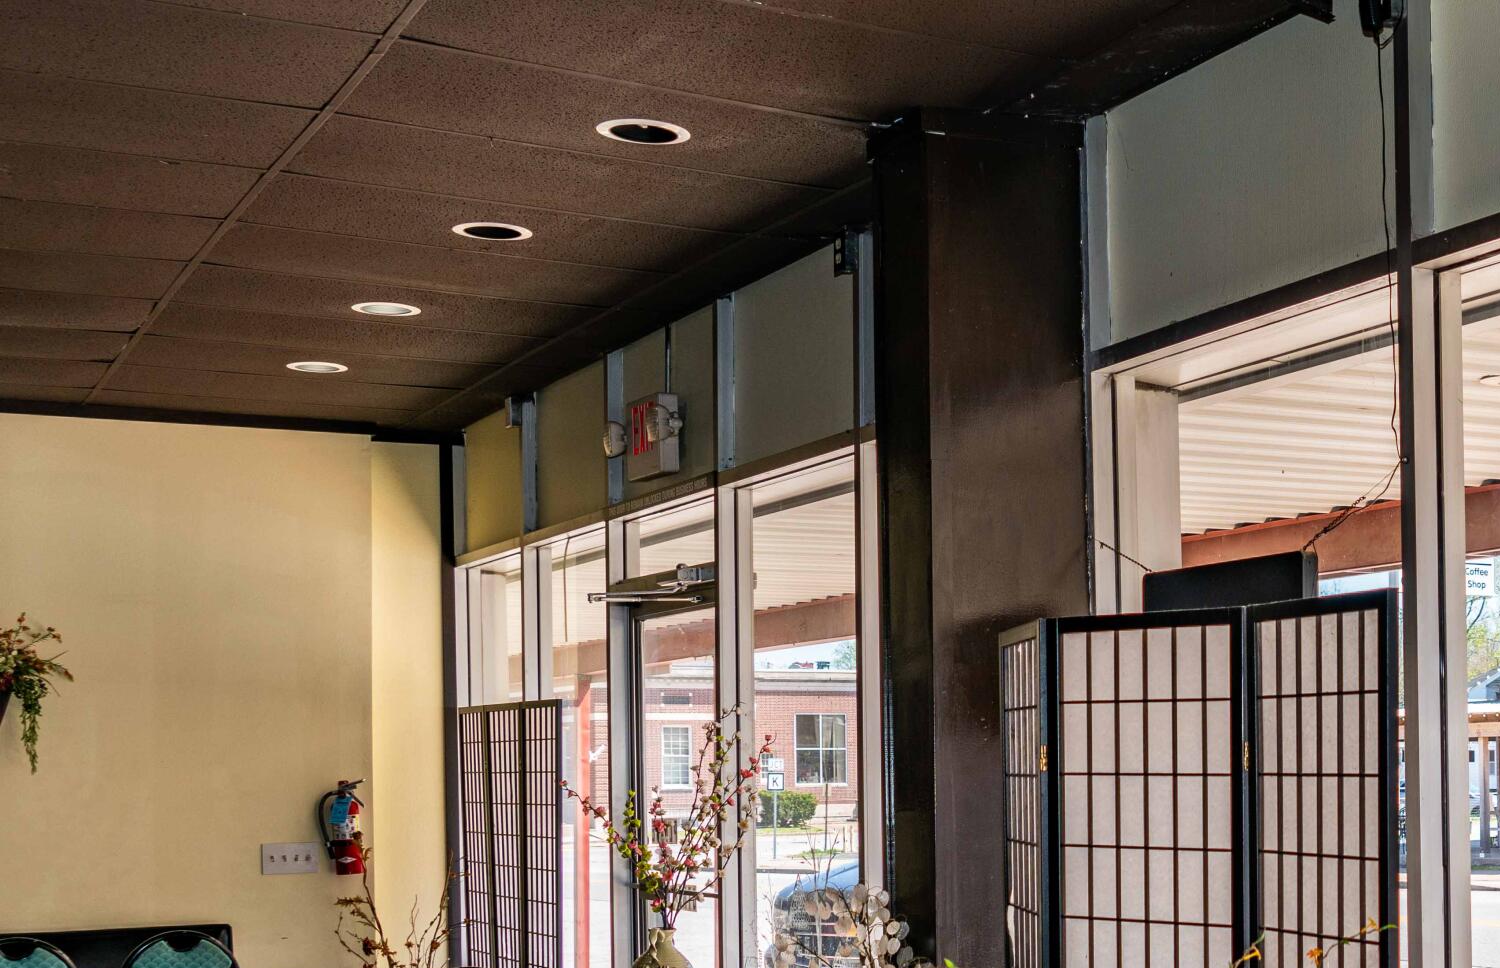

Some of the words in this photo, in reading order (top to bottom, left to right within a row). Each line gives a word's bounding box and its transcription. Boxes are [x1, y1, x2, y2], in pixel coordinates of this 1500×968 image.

[1465, 567, 1489, 576] Coffee
[1467, 580, 1487, 589] Shop
[772, 776, 779, 787] K
